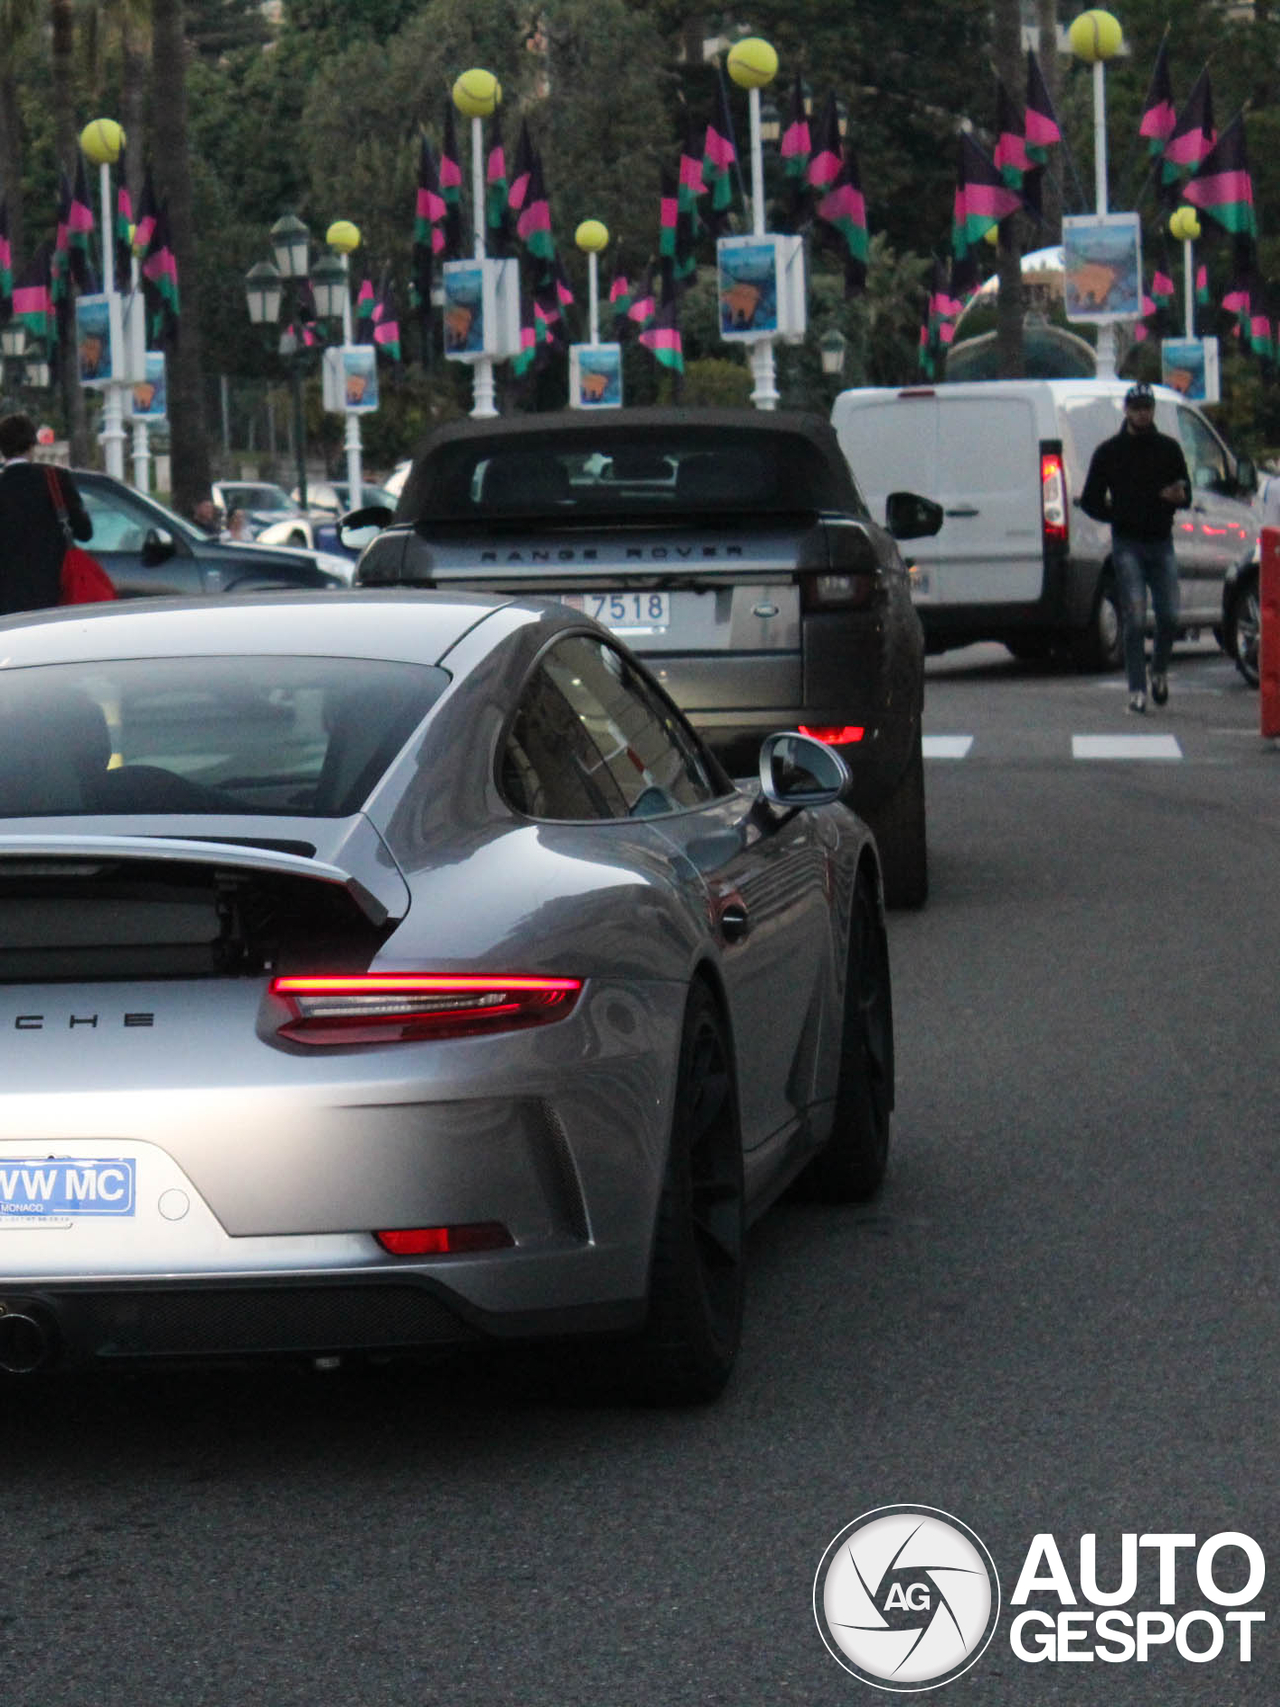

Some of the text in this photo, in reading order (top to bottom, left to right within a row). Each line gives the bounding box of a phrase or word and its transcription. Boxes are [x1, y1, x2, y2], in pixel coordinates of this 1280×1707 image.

[480, 546, 744, 562] RANGE ROVER
[590, 593, 664, 620] 7518
[64, 1168, 125, 1201] MC
[0, 1203, 44, 1213] MONACO
